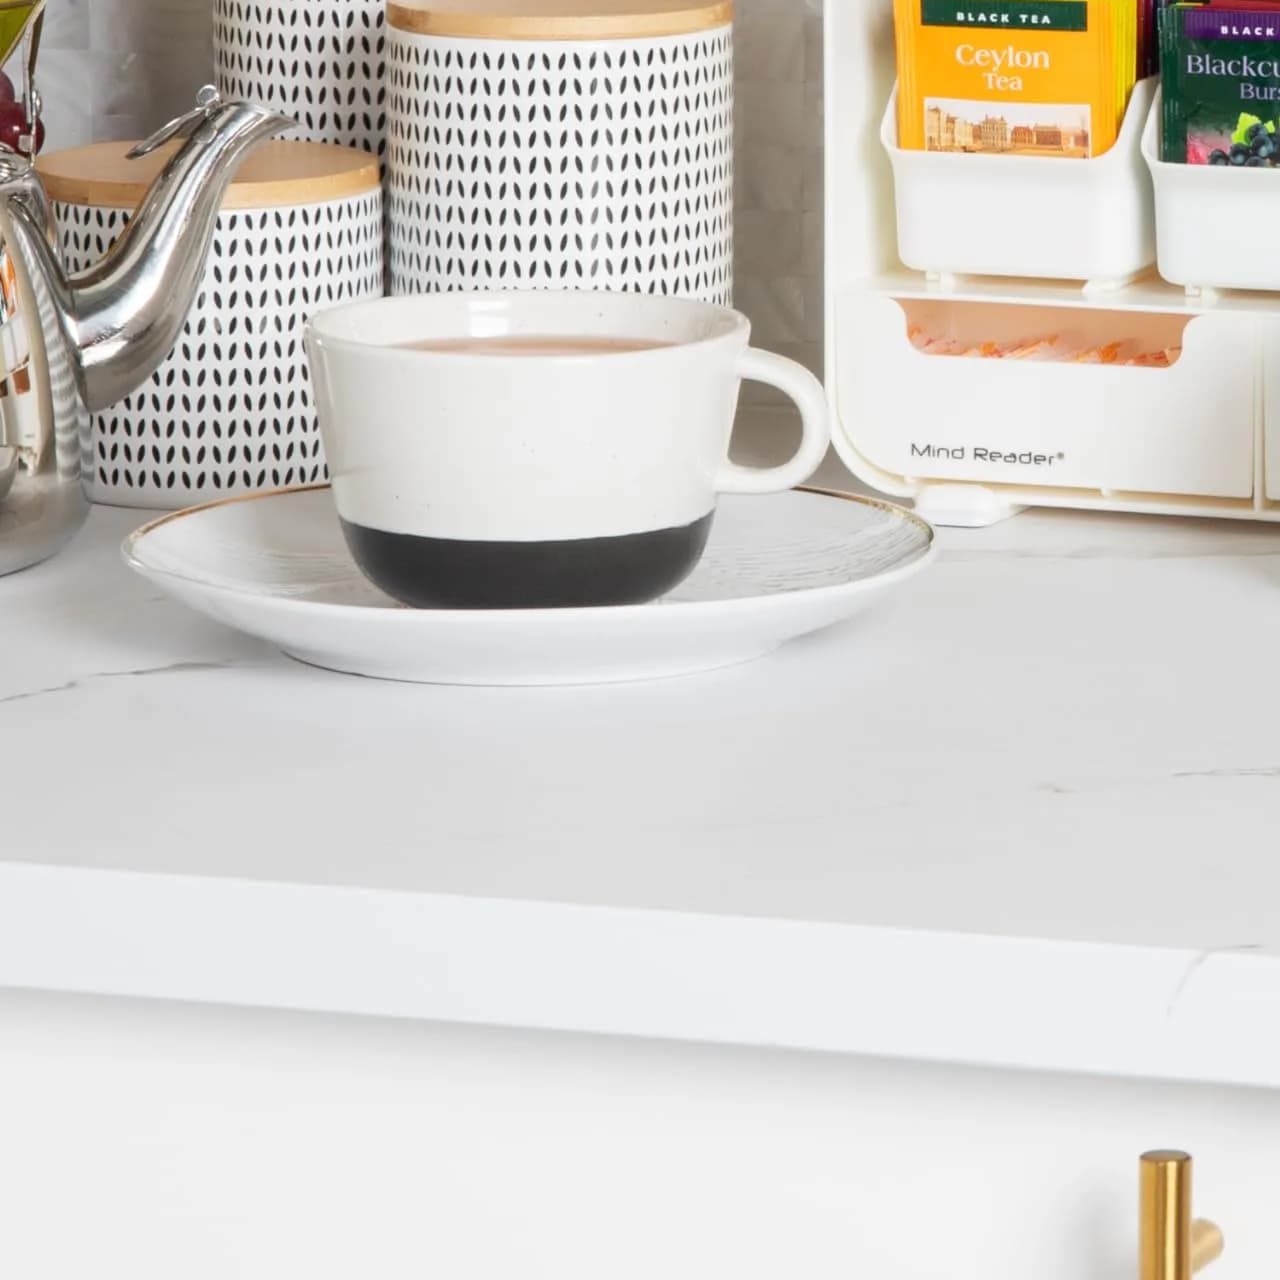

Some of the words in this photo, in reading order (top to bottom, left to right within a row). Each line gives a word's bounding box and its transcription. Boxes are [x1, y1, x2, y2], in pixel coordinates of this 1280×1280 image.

[956, 12, 1010, 23] BLACK
[1020, 14, 1051, 24] TEA
[1221, 26, 1274, 36] BLACK
[955, 44, 1050, 71] Ceylon
[983, 72, 1023, 91] Tea
[911, 443, 965, 459] Mind
